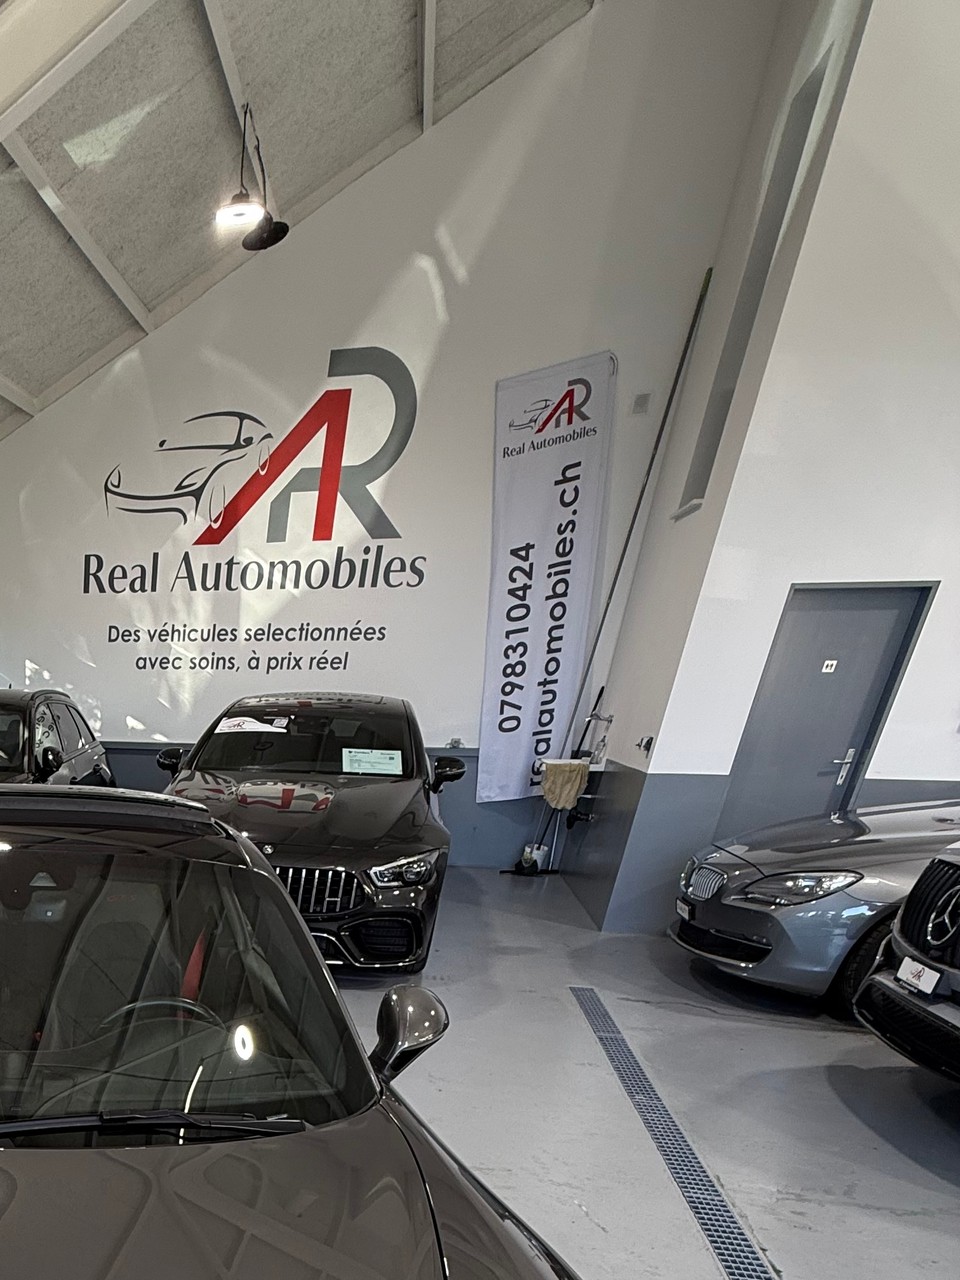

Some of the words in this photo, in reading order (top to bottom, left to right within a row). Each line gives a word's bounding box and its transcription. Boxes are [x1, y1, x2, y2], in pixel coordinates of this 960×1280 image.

[502, 441, 526, 459] Real
[527, 426, 598, 453] Automobiles
[82, 551, 160, 595] Real
[170, 544, 428, 593] Automobiles
[108, 624, 141, 643] Des
[147, 622, 239, 643] véhicules
[243, 620, 387, 643] selectionnées
[498, 541, 536, 734] 0798310424
[135, 655, 183, 671] avec
[189, 652, 241, 673] soins,
[247, 650, 260, 671] à
[266, 652, 304, 675] prix
[308, 650, 349, 671] réel
